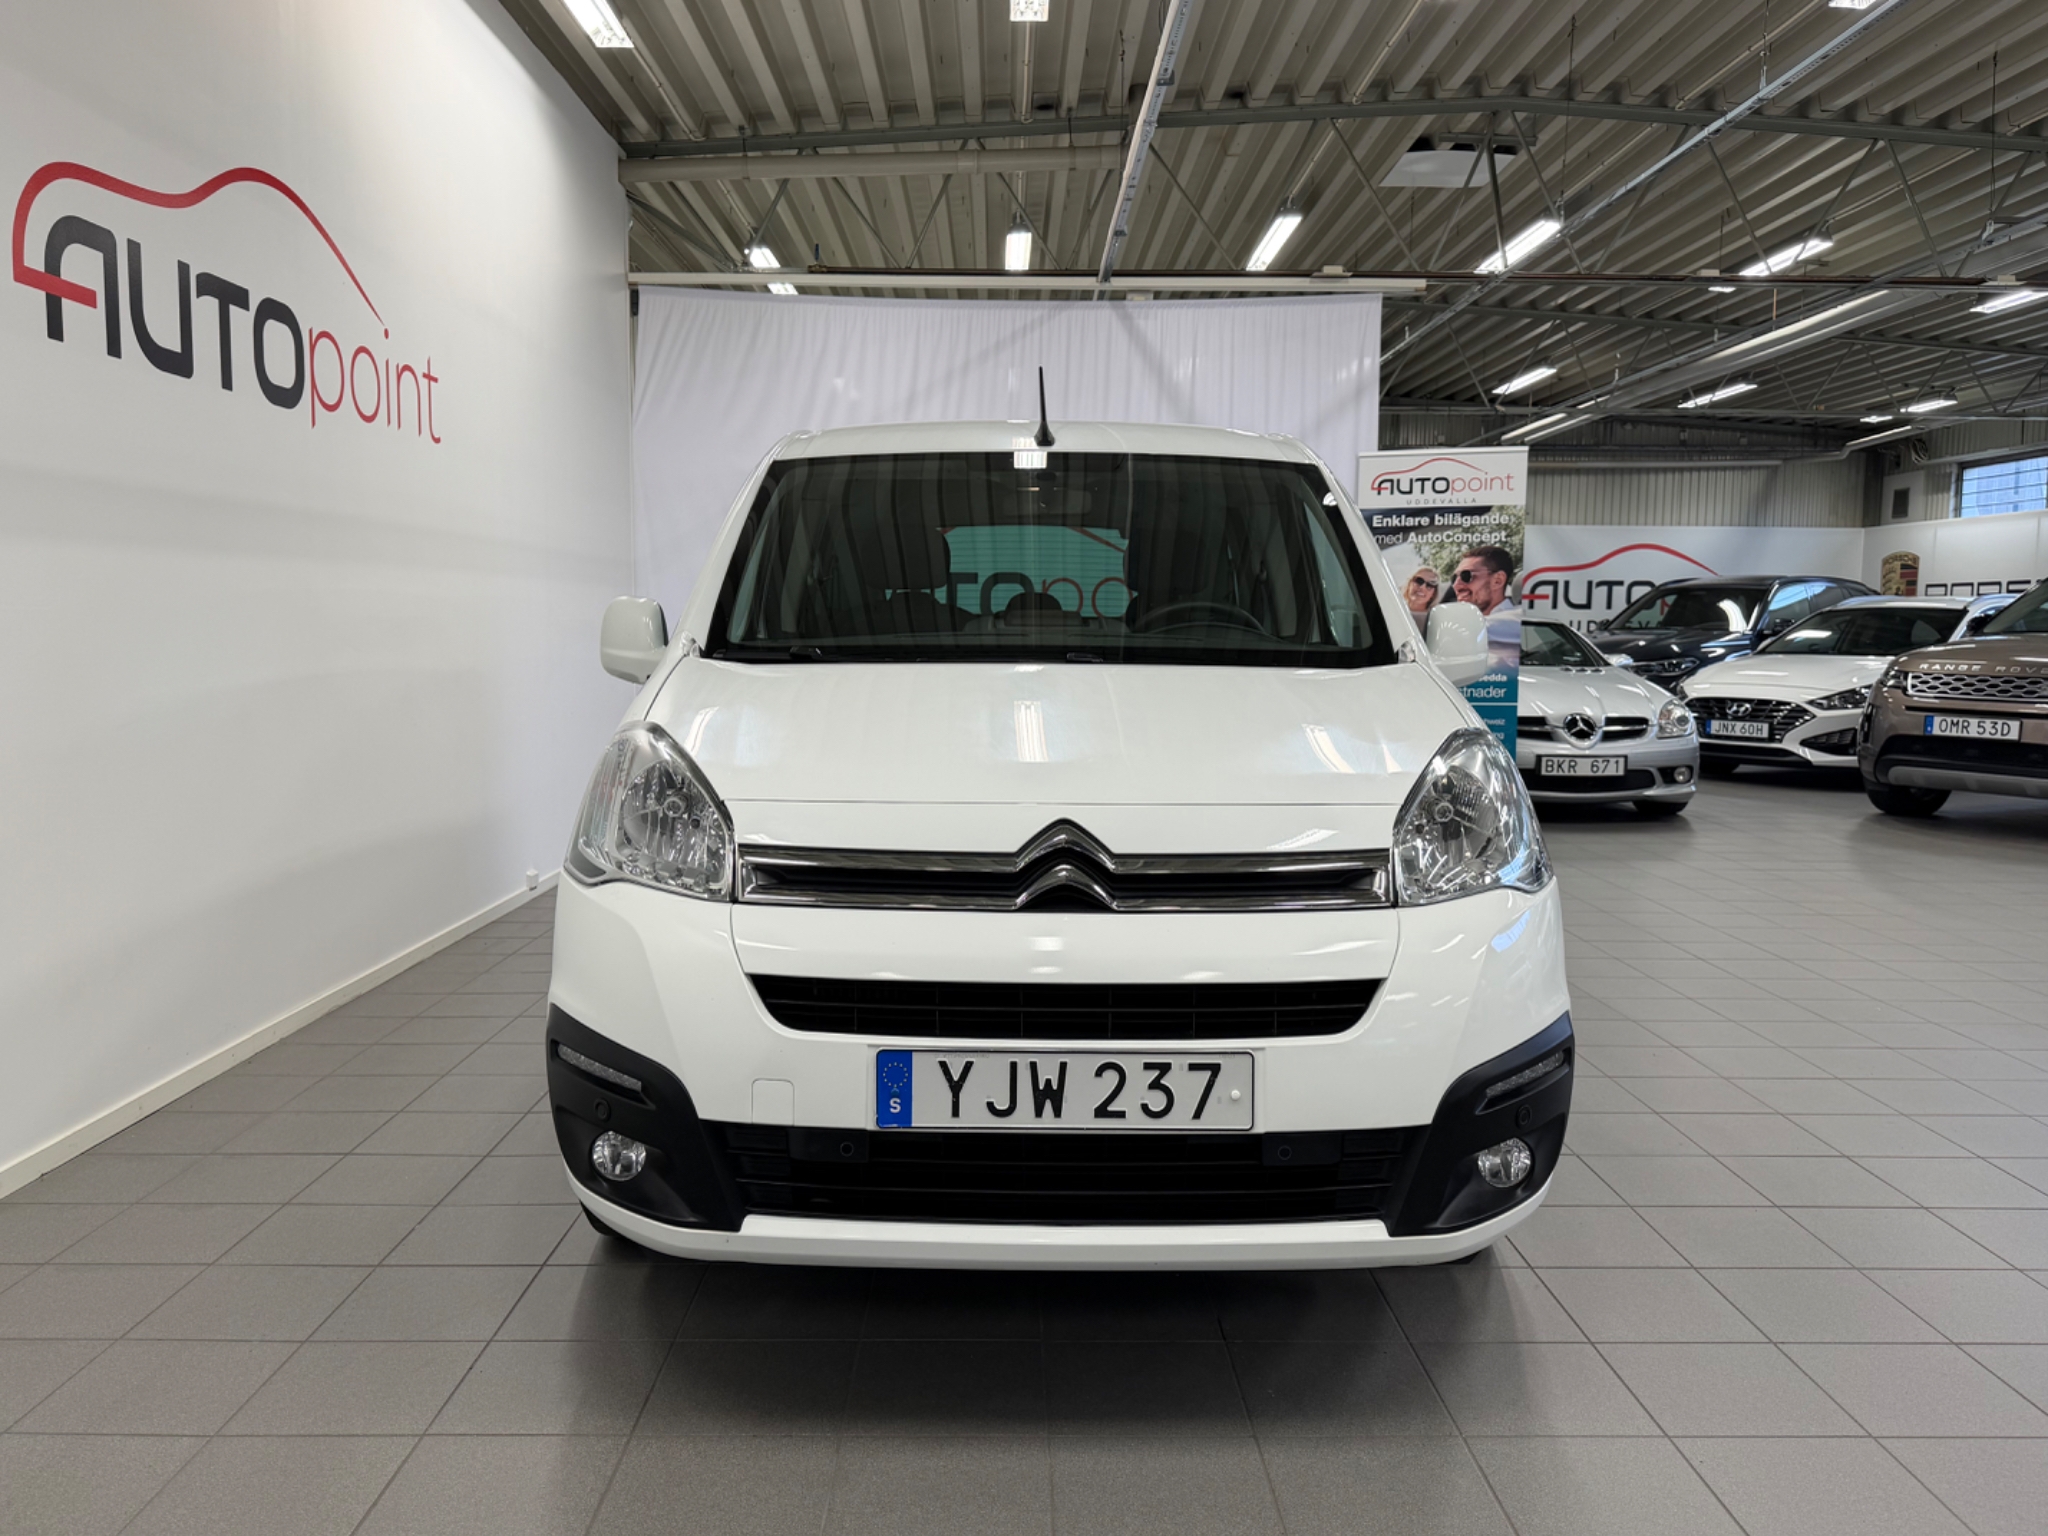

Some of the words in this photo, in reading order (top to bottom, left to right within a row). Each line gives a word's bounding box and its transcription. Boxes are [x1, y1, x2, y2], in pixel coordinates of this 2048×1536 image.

[1375, 471, 1515, 496] AUTOpoint
[1406, 498, 1477, 506] UDDEVALLA
[1371, 514, 1431, 528] Enklare
[1434, 513, 1510, 527] bilägande
[1374, 532, 1403, 544] med
[1919, 663, 1982, 672] RANGE
[1714, 721, 1737, 734] JNX
[1739, 723, 1764, 736] 60H
[1938, 718, 1971, 735] OMR
[1976, 720, 2012, 737] 53D
[1545, 759, 1578, 774] BKR
[1590, 760, 1620, 774] 671
[937, 1059, 1068, 1119] YJW
[1093, 1060, 1222, 1120] 237
[889, 1097, 901, 1113] S
